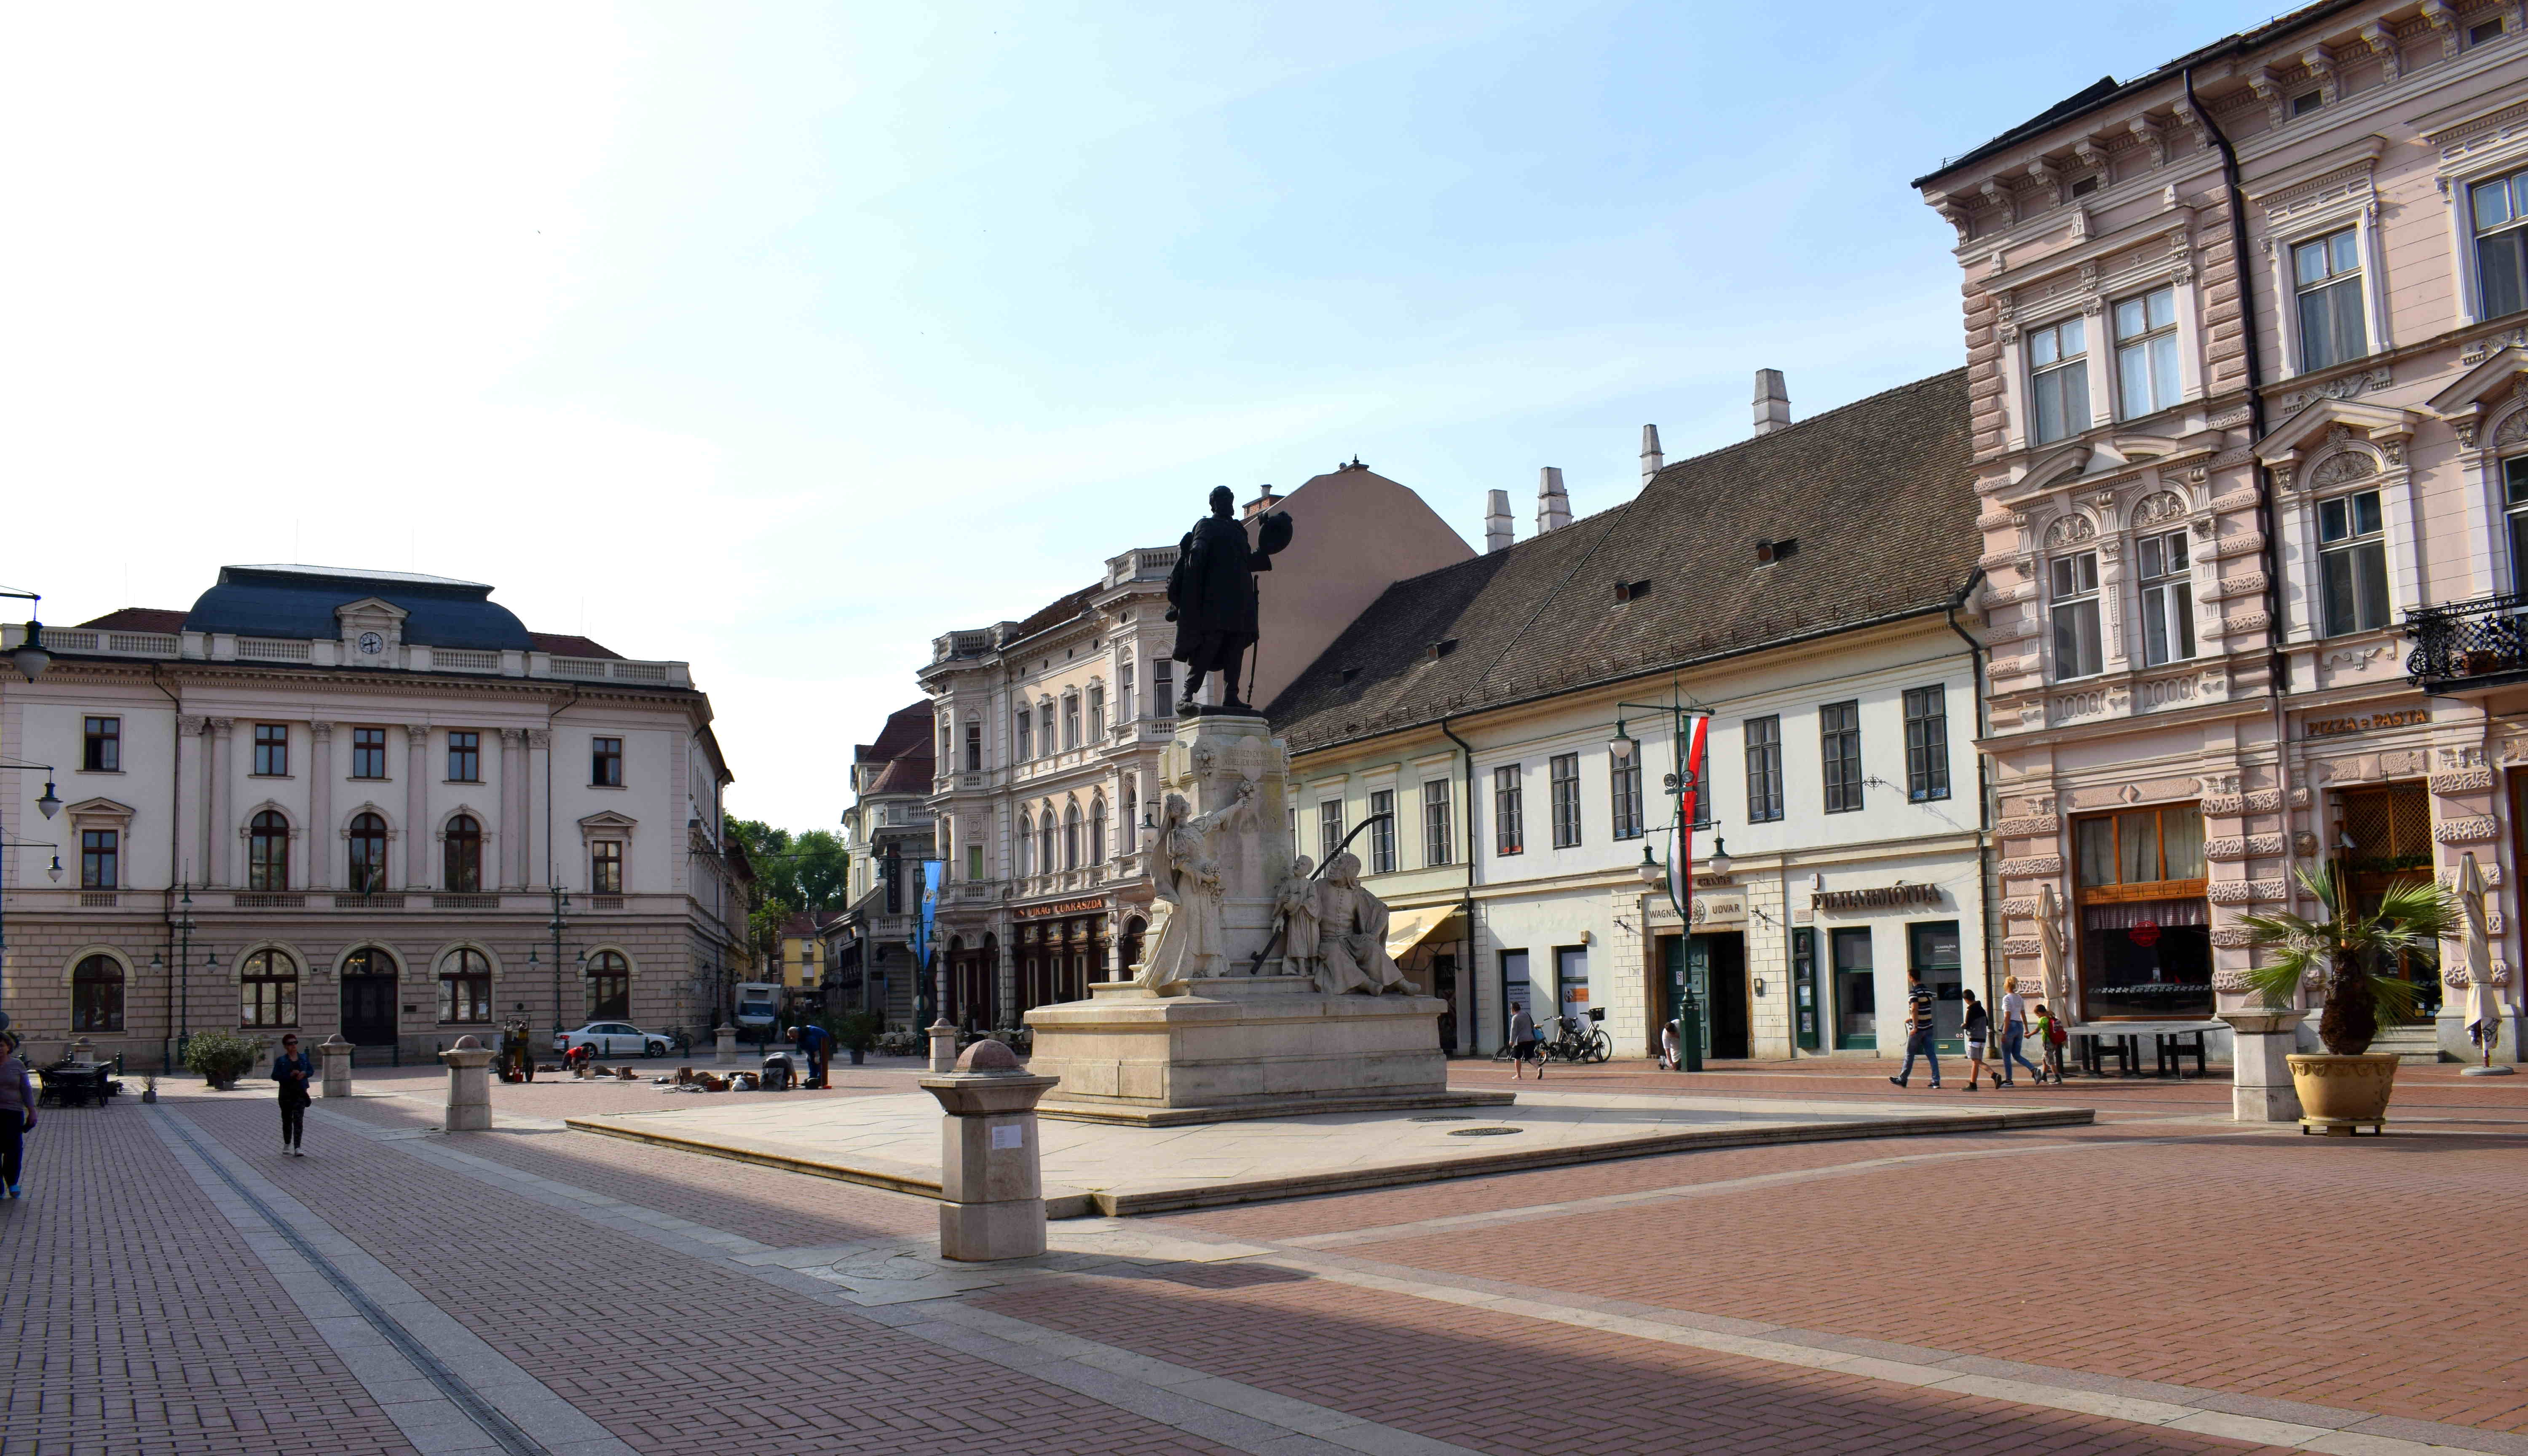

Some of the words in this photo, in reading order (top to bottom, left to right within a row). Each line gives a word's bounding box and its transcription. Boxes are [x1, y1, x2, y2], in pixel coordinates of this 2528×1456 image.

[2306, 717, 2357, 735] PIZZA
[2360, 718, 2369, 728] e
[2372, 709, 2427, 728] PASTA
[1810, 880, 1942, 910] FILHARMÓNIA
[1649, 909, 1679, 918] WAGNE
[1712, 903, 1740, 914] UDVAR
